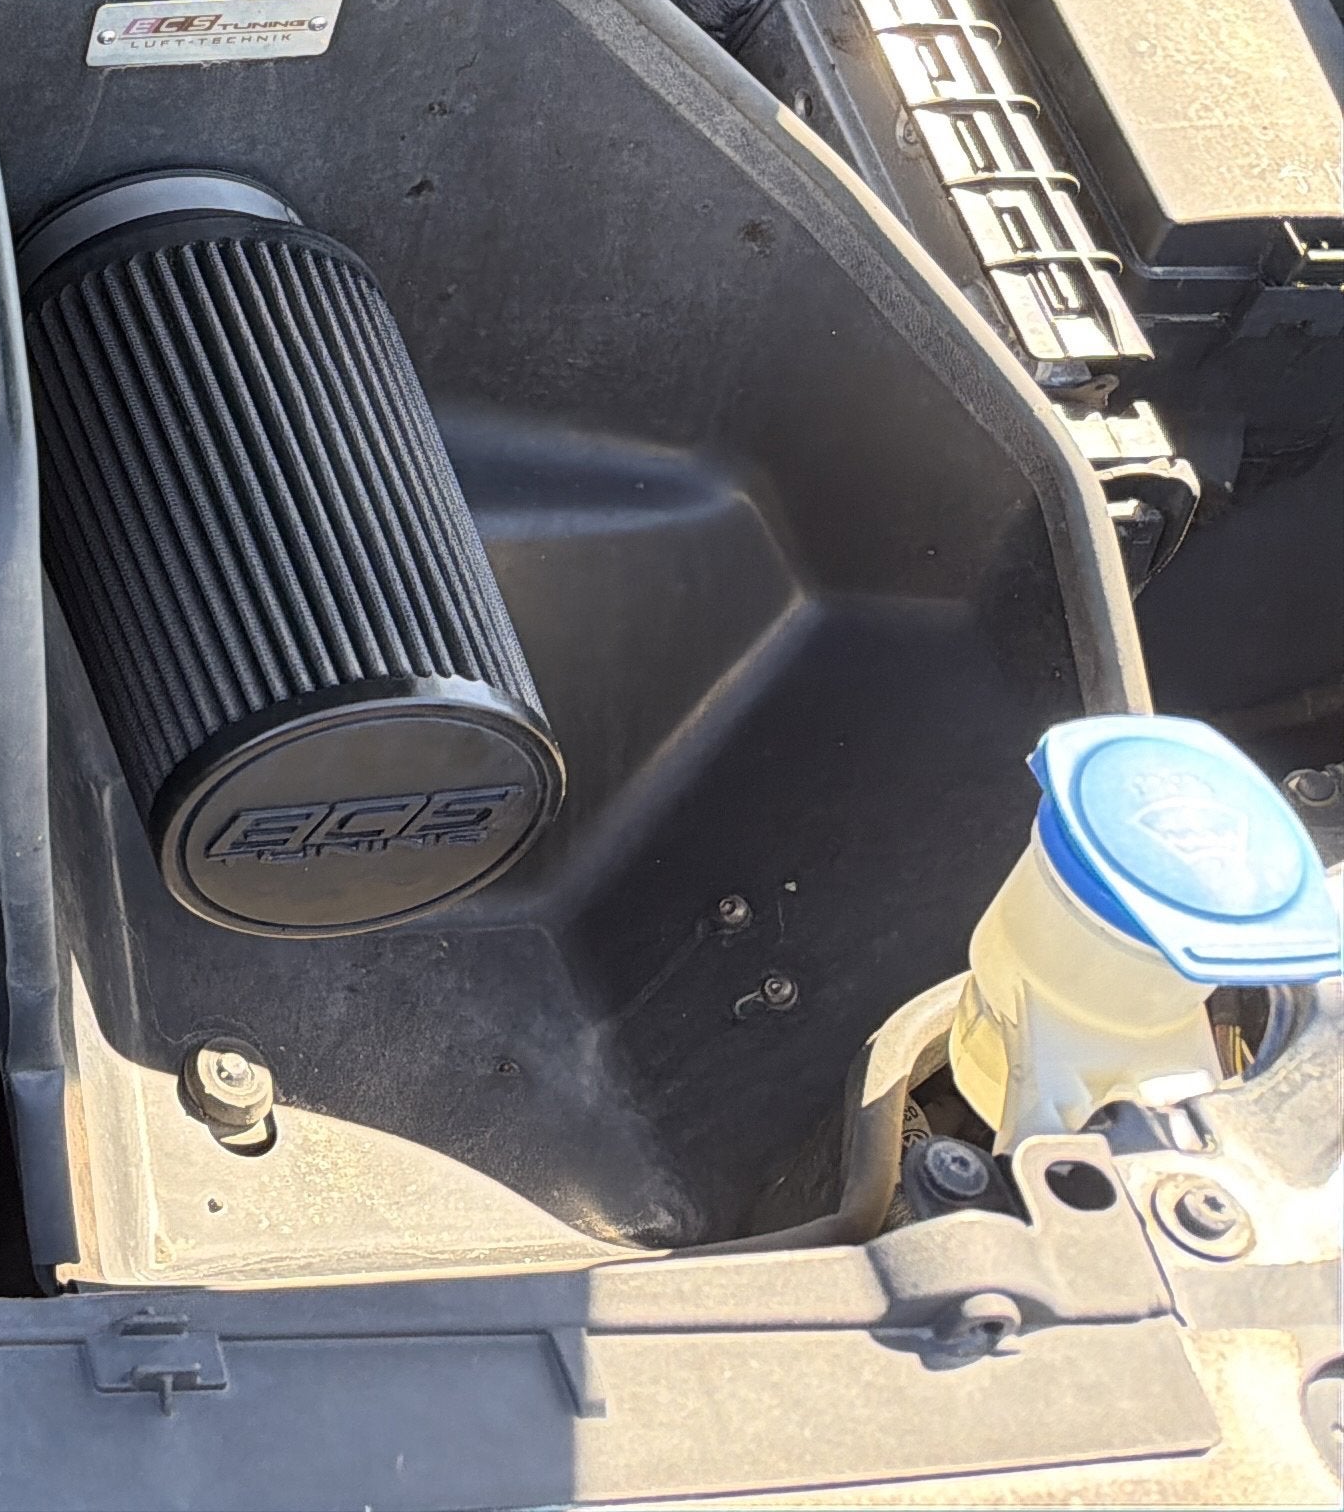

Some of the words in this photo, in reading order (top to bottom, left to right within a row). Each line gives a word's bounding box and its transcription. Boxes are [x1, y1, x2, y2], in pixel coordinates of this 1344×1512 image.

[123, 14, 223, 36] ECS
[216, 19, 308, 31] TUNING
[130, 34, 293, 49] LUFT-TECHNIK
[204, 785, 524, 860] ECS
